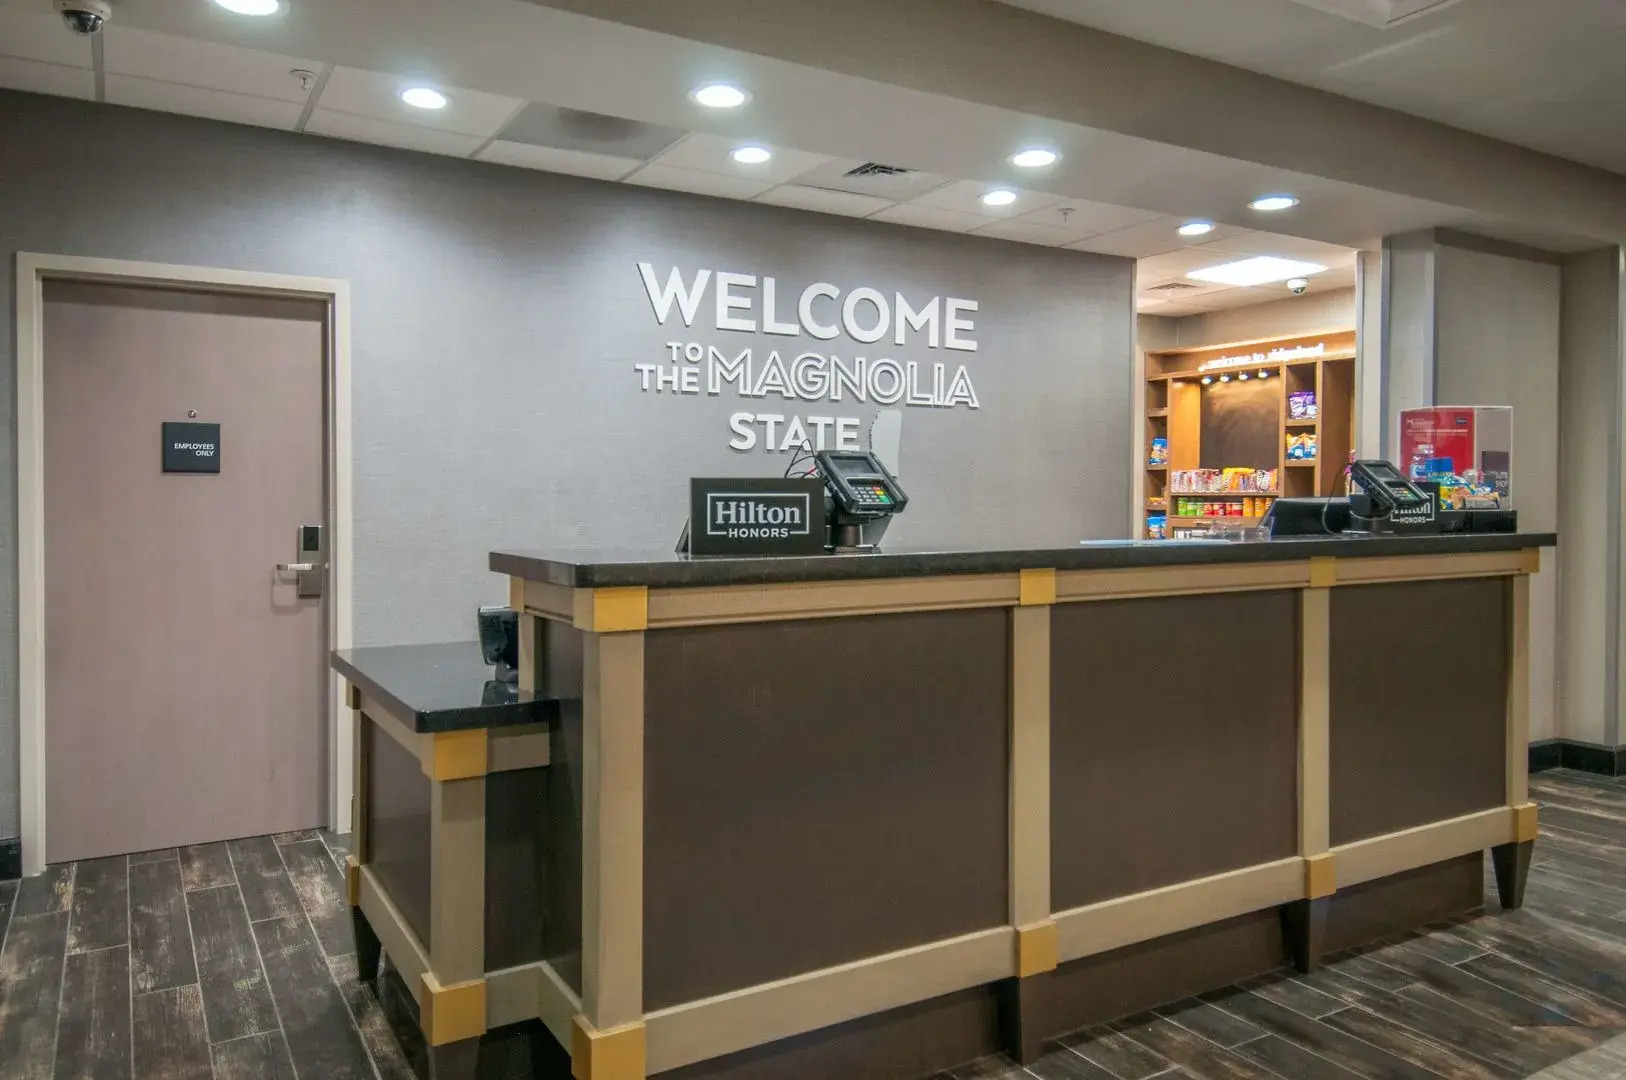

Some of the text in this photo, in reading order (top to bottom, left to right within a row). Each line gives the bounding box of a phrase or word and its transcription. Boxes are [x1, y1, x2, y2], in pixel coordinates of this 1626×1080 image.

[637, 263, 978, 351] WELCOME
[666, 341, 704, 363] TO
[634, 345, 979, 408] THE MAGNOLIA
[729, 412, 860, 451] STATE
[715, 501, 801, 525] Hilton
[1399, 516, 1426, 524] HONORS
[728, 527, 789, 538] HONORS
